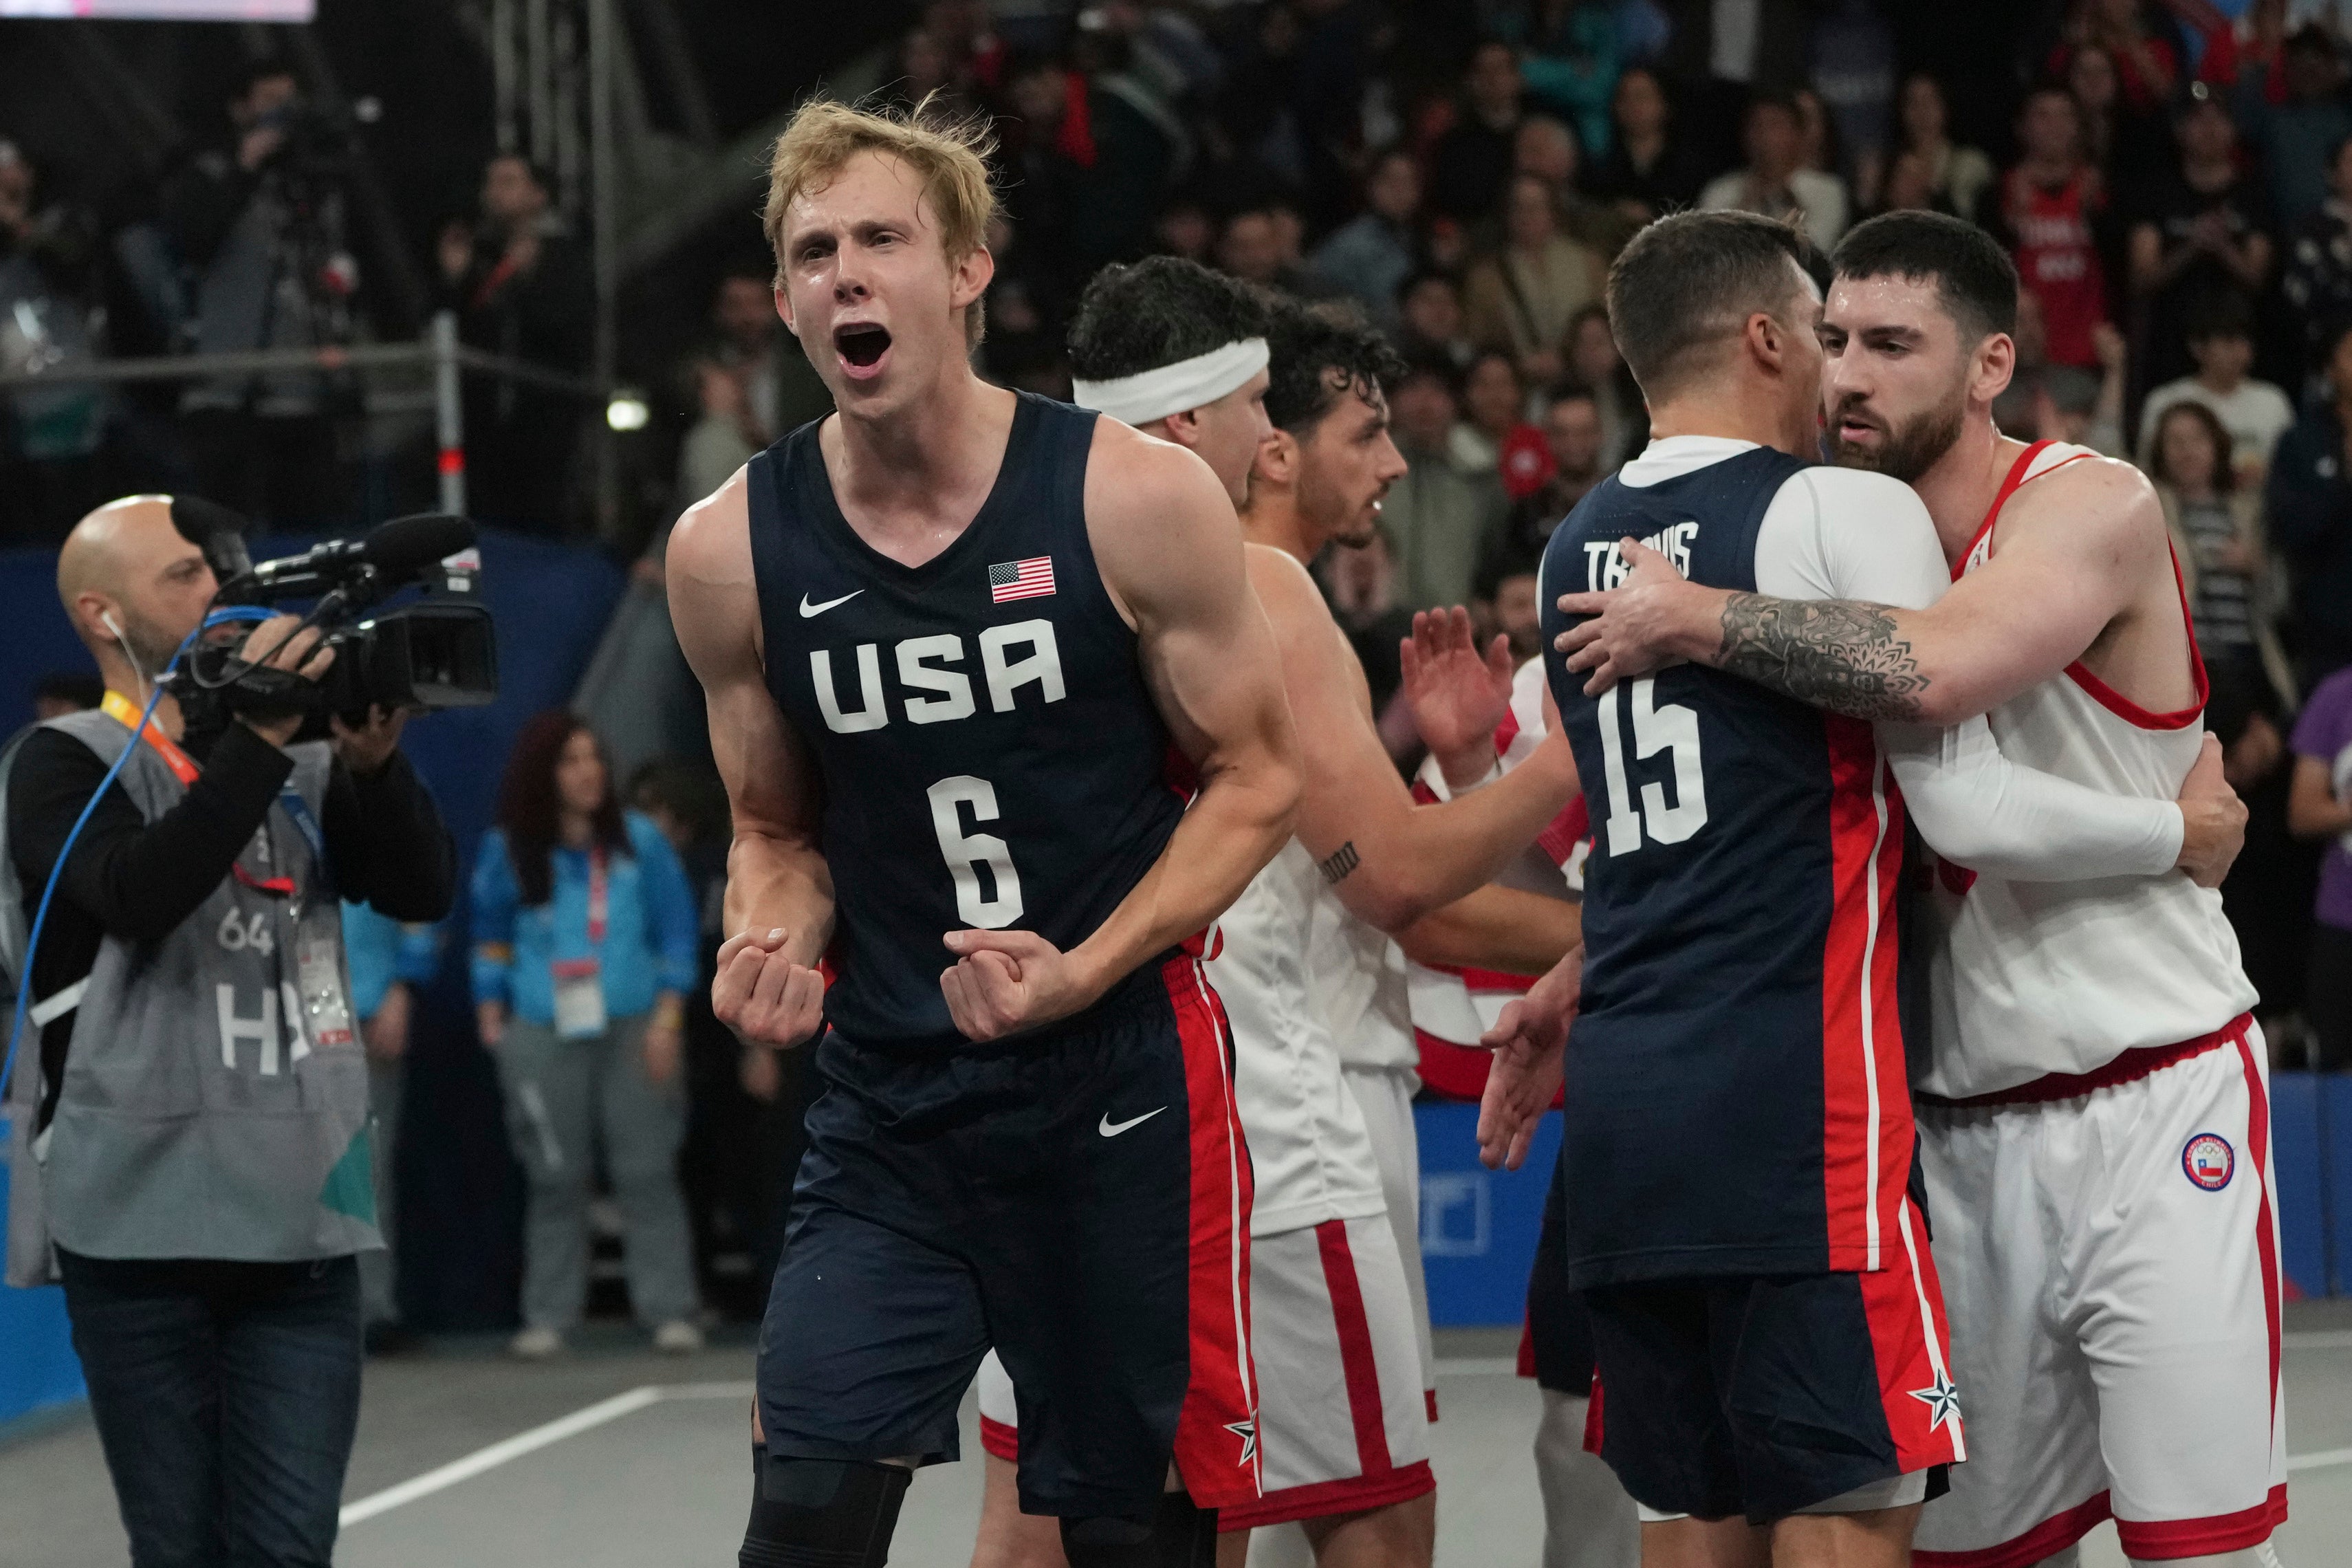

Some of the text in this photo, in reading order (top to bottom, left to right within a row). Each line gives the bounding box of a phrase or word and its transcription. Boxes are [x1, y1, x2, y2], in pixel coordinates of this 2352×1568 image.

[1584, 522, 1699, 592] TRIS
[810, 619, 1065, 733] USA
[1598, 678, 1708, 857] 15
[926, 775, 1023, 928] 6
[217, 906, 274, 956] 64
